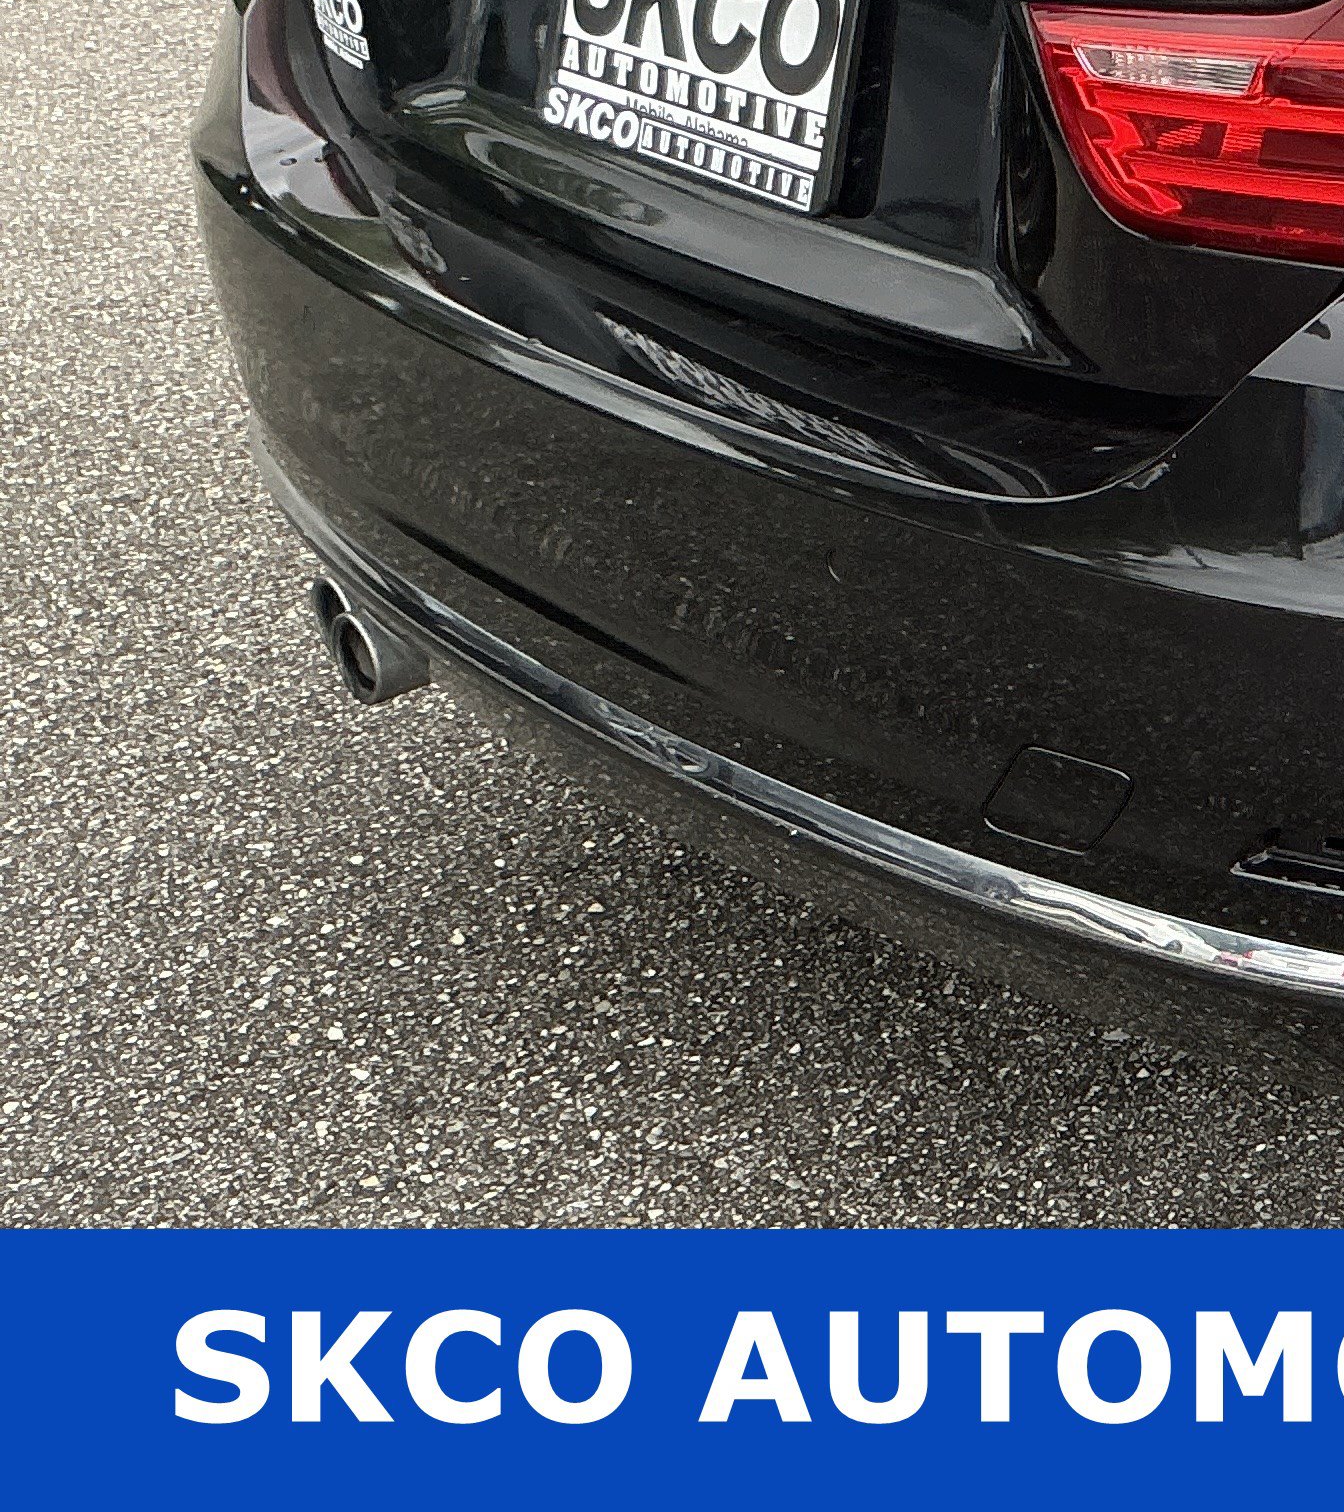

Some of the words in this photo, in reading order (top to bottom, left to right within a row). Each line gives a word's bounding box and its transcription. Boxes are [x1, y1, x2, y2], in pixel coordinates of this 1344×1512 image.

[543, 87, 640, 149] SKCO
[642, 125, 812, 202] AUTOMOTIVE
[562, 36, 828, 149] AUTOMOTIVE
